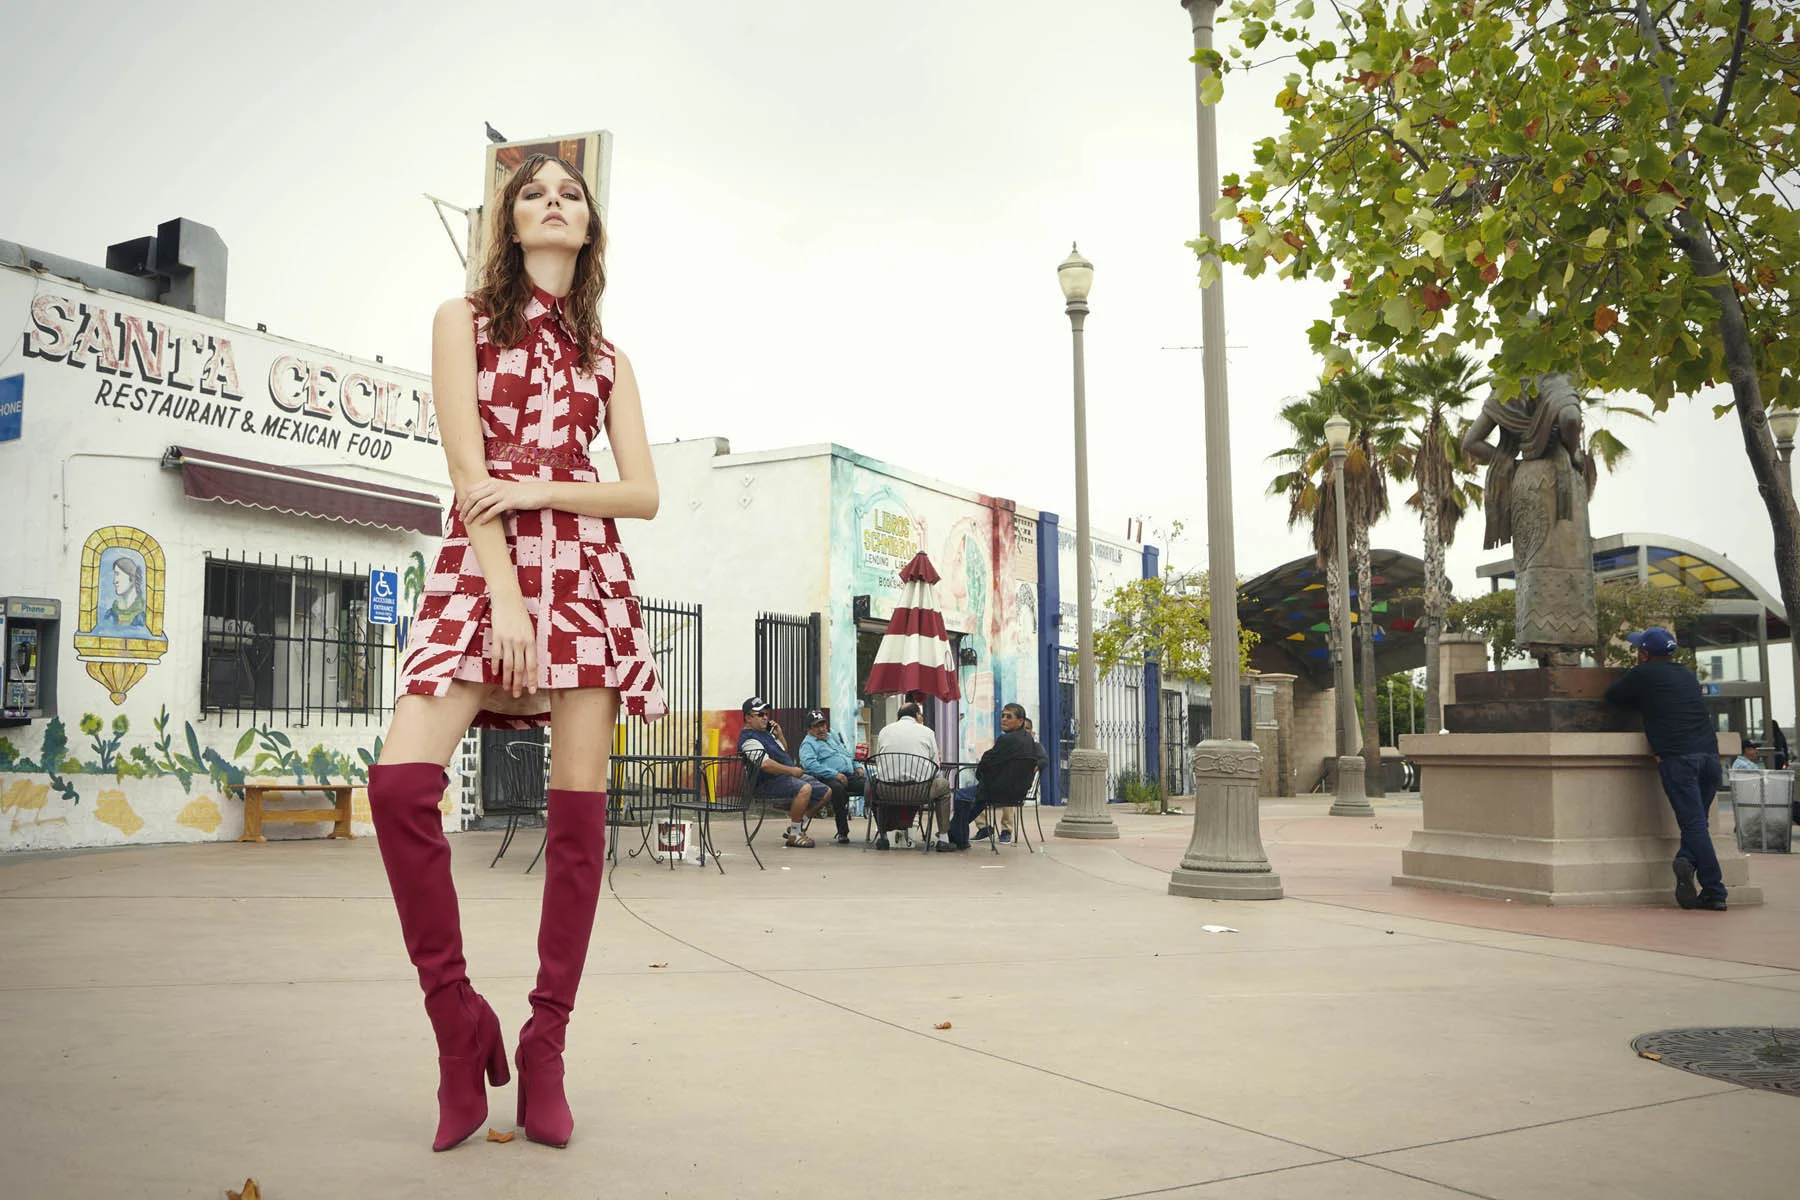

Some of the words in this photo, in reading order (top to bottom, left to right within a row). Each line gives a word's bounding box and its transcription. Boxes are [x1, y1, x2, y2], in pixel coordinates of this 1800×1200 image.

[24, 294, 246, 402] SANTA
[95, 379, 242, 430] RESTAURANT
[241, 410, 257, 434] &
[261, 414, 342, 450] MEXICAN
[347, 433, 393, 461] FOOD
[874, 508, 910, 538] LIBROS
[865, 553, 889, 567] LENDING
[21, 604, 46, 614] Phone
